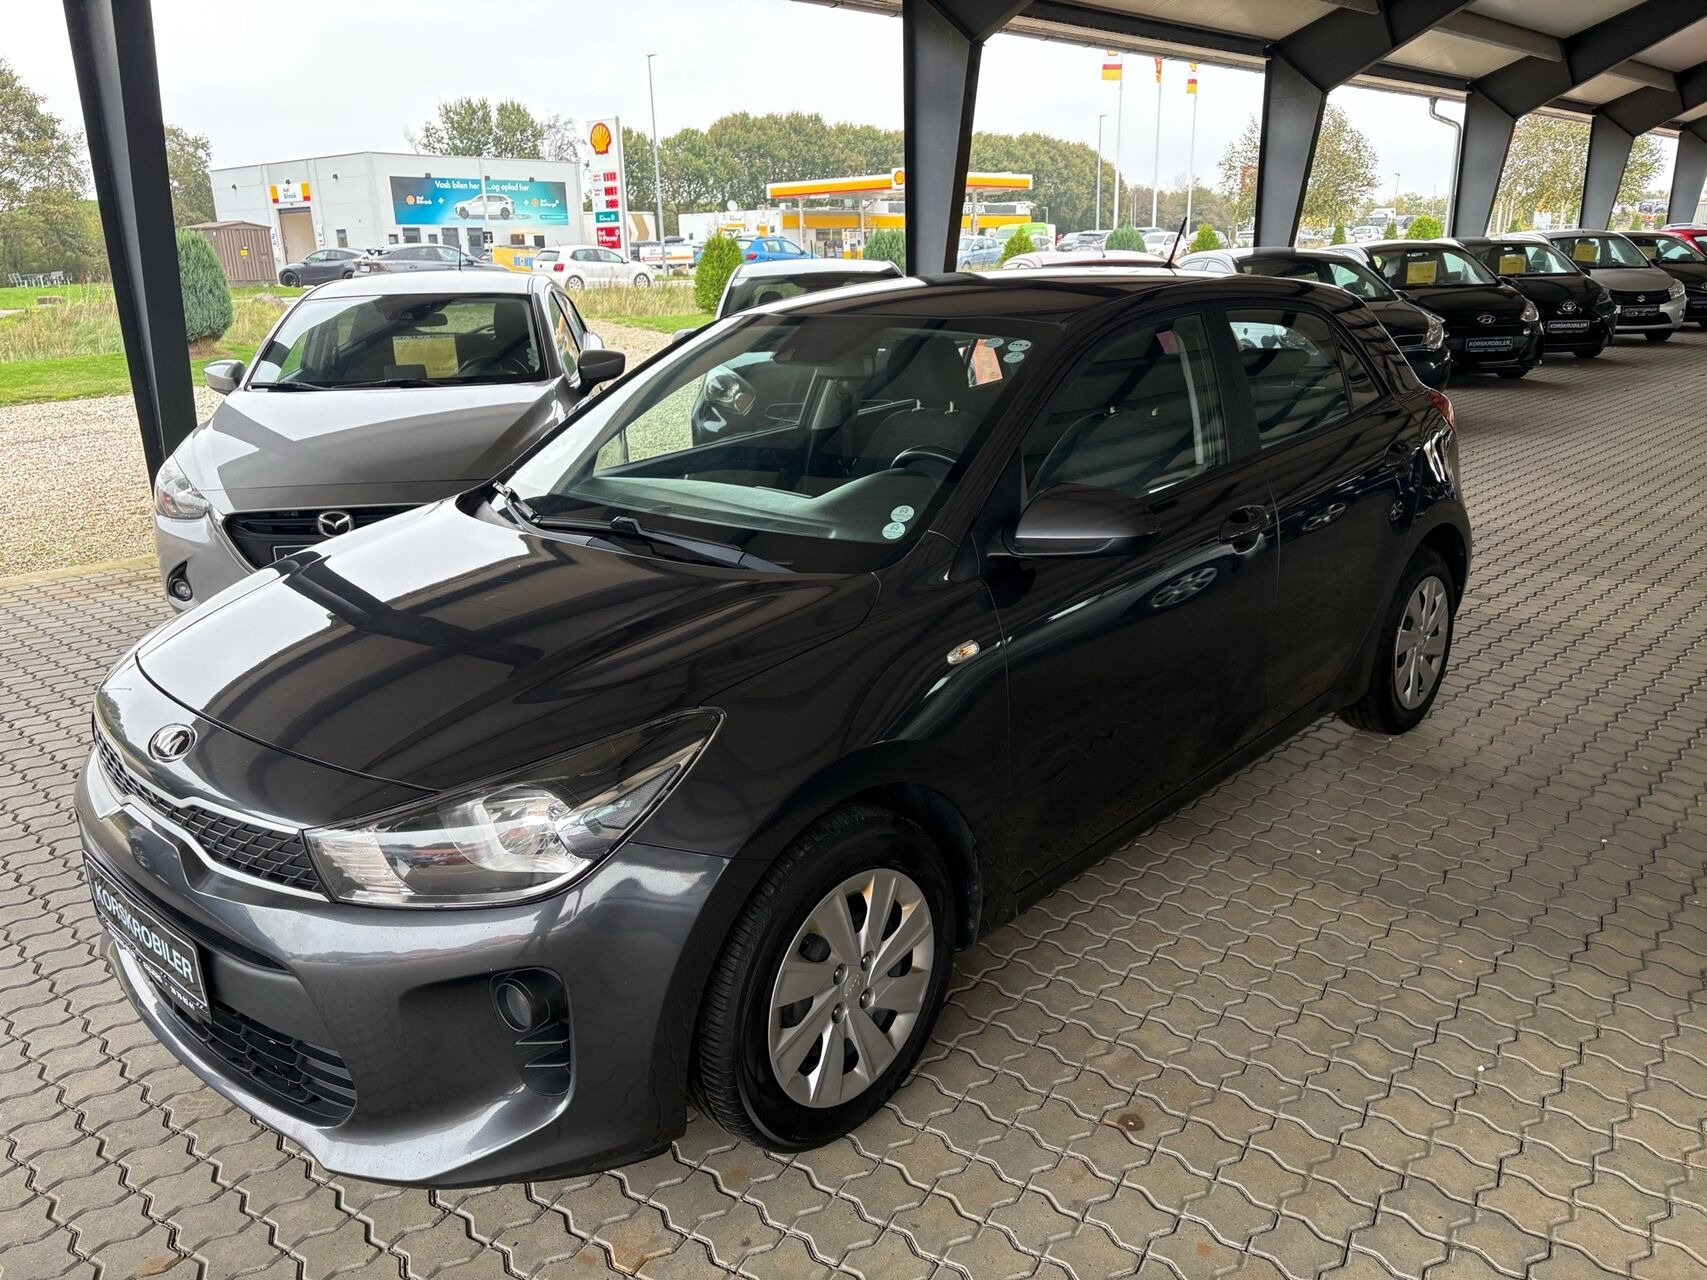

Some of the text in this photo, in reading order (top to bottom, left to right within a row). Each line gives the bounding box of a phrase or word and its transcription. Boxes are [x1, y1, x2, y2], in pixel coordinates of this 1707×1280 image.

[435, 180, 480, 189] Vask bilen her
[501, 182, 518, 192] oplad
[519, 183, 529, 191] her
[95, 881, 194, 983] KORSKROBILER
